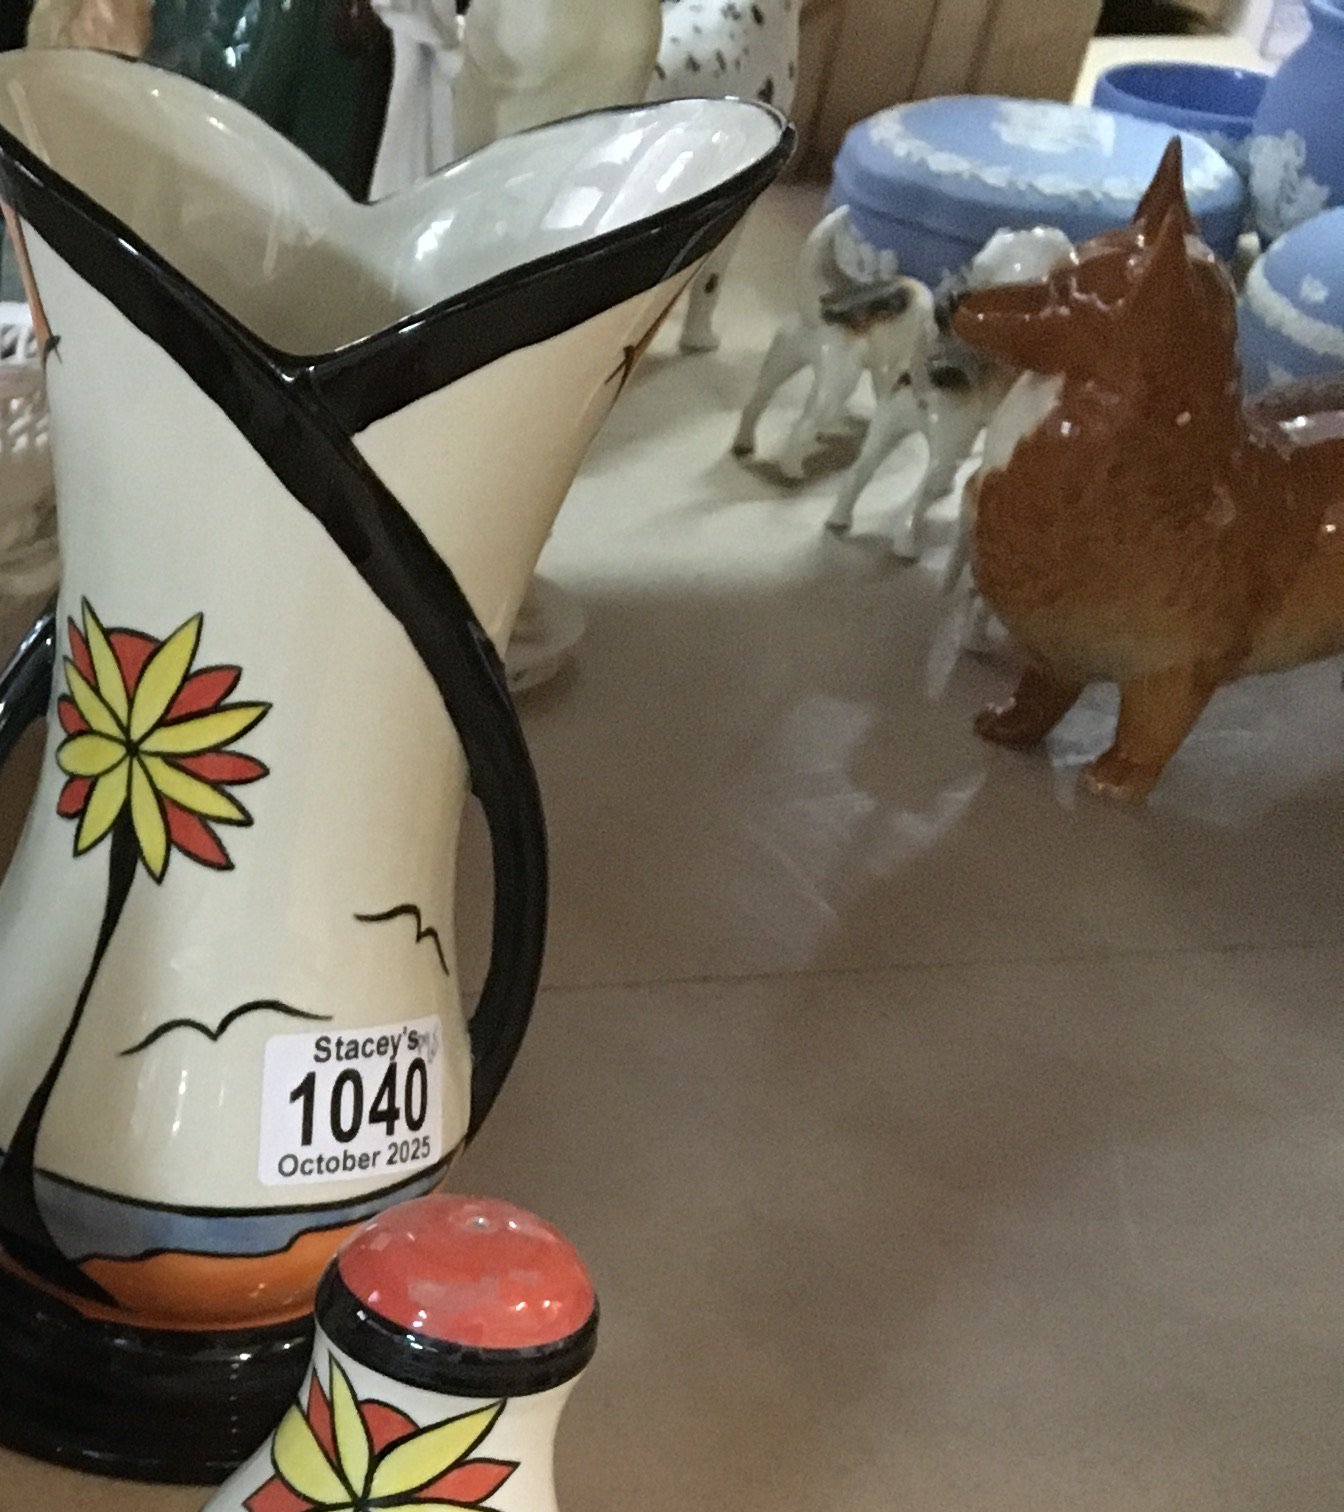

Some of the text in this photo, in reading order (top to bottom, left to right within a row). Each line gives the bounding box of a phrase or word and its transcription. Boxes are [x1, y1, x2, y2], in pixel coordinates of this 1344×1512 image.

[313, 1026, 419, 1063] Stacey's
[289, 1057, 427, 1146] 1040
[278, 1135, 431, 1177] October 2025
